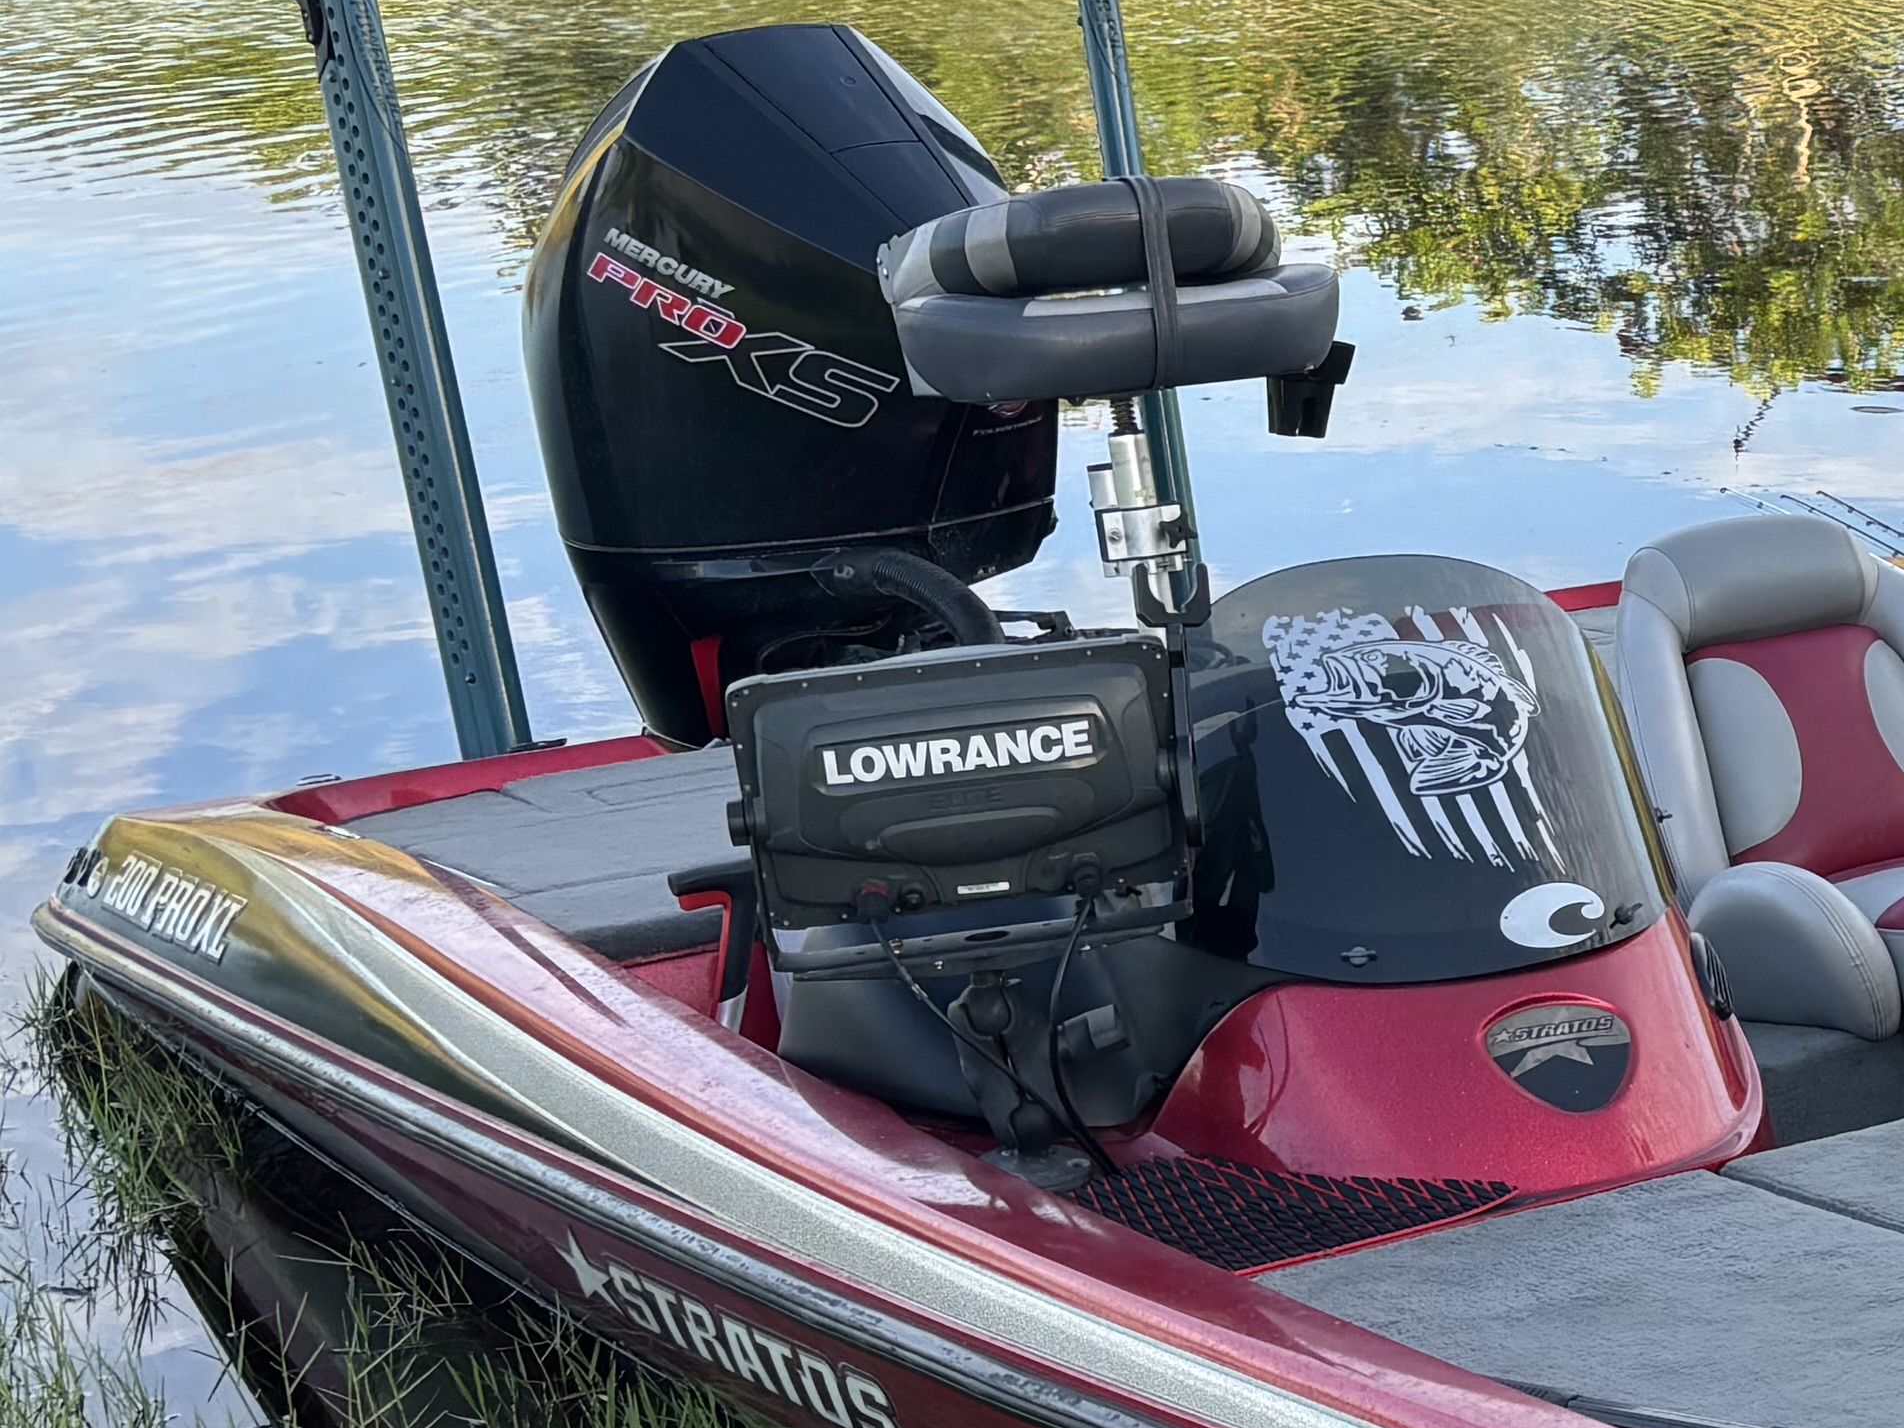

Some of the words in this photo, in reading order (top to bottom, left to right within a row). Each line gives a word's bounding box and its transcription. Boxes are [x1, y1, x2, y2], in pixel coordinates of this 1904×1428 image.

[604, 227, 735, 299] MERCURY
[587, 252, 747, 349] PRO
[657, 331, 900, 428] XS
[822, 720, 1093, 785] LOWRANCE
[103, 854, 161, 918] 200
[1513, 1015, 1614, 1042] STRATOS
